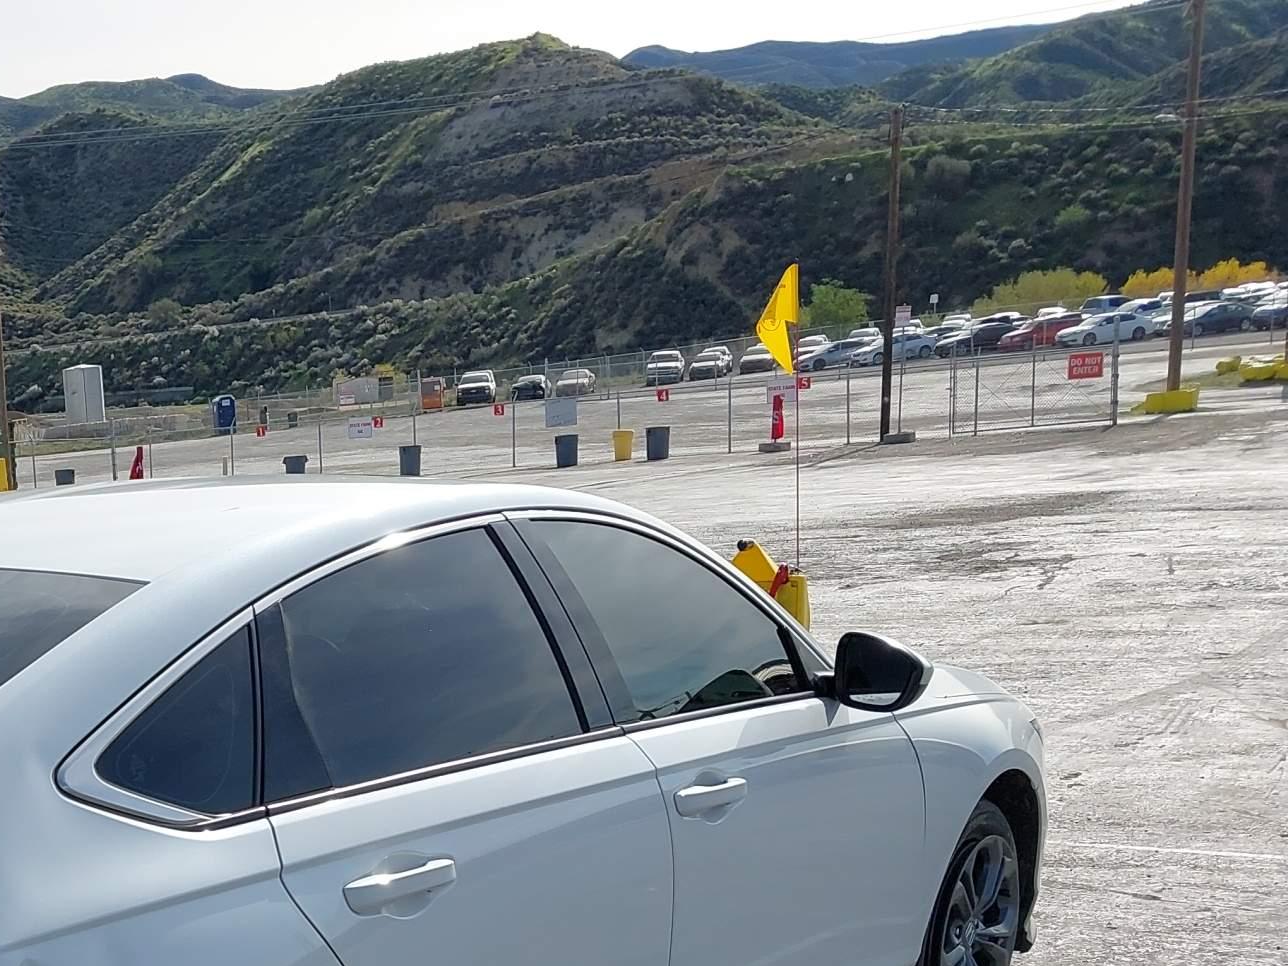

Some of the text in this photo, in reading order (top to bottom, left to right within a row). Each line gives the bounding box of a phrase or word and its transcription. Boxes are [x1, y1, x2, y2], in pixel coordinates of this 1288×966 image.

[1070, 356, 1102, 366] DO NOT
[1073, 365, 1099, 375] ENTER
